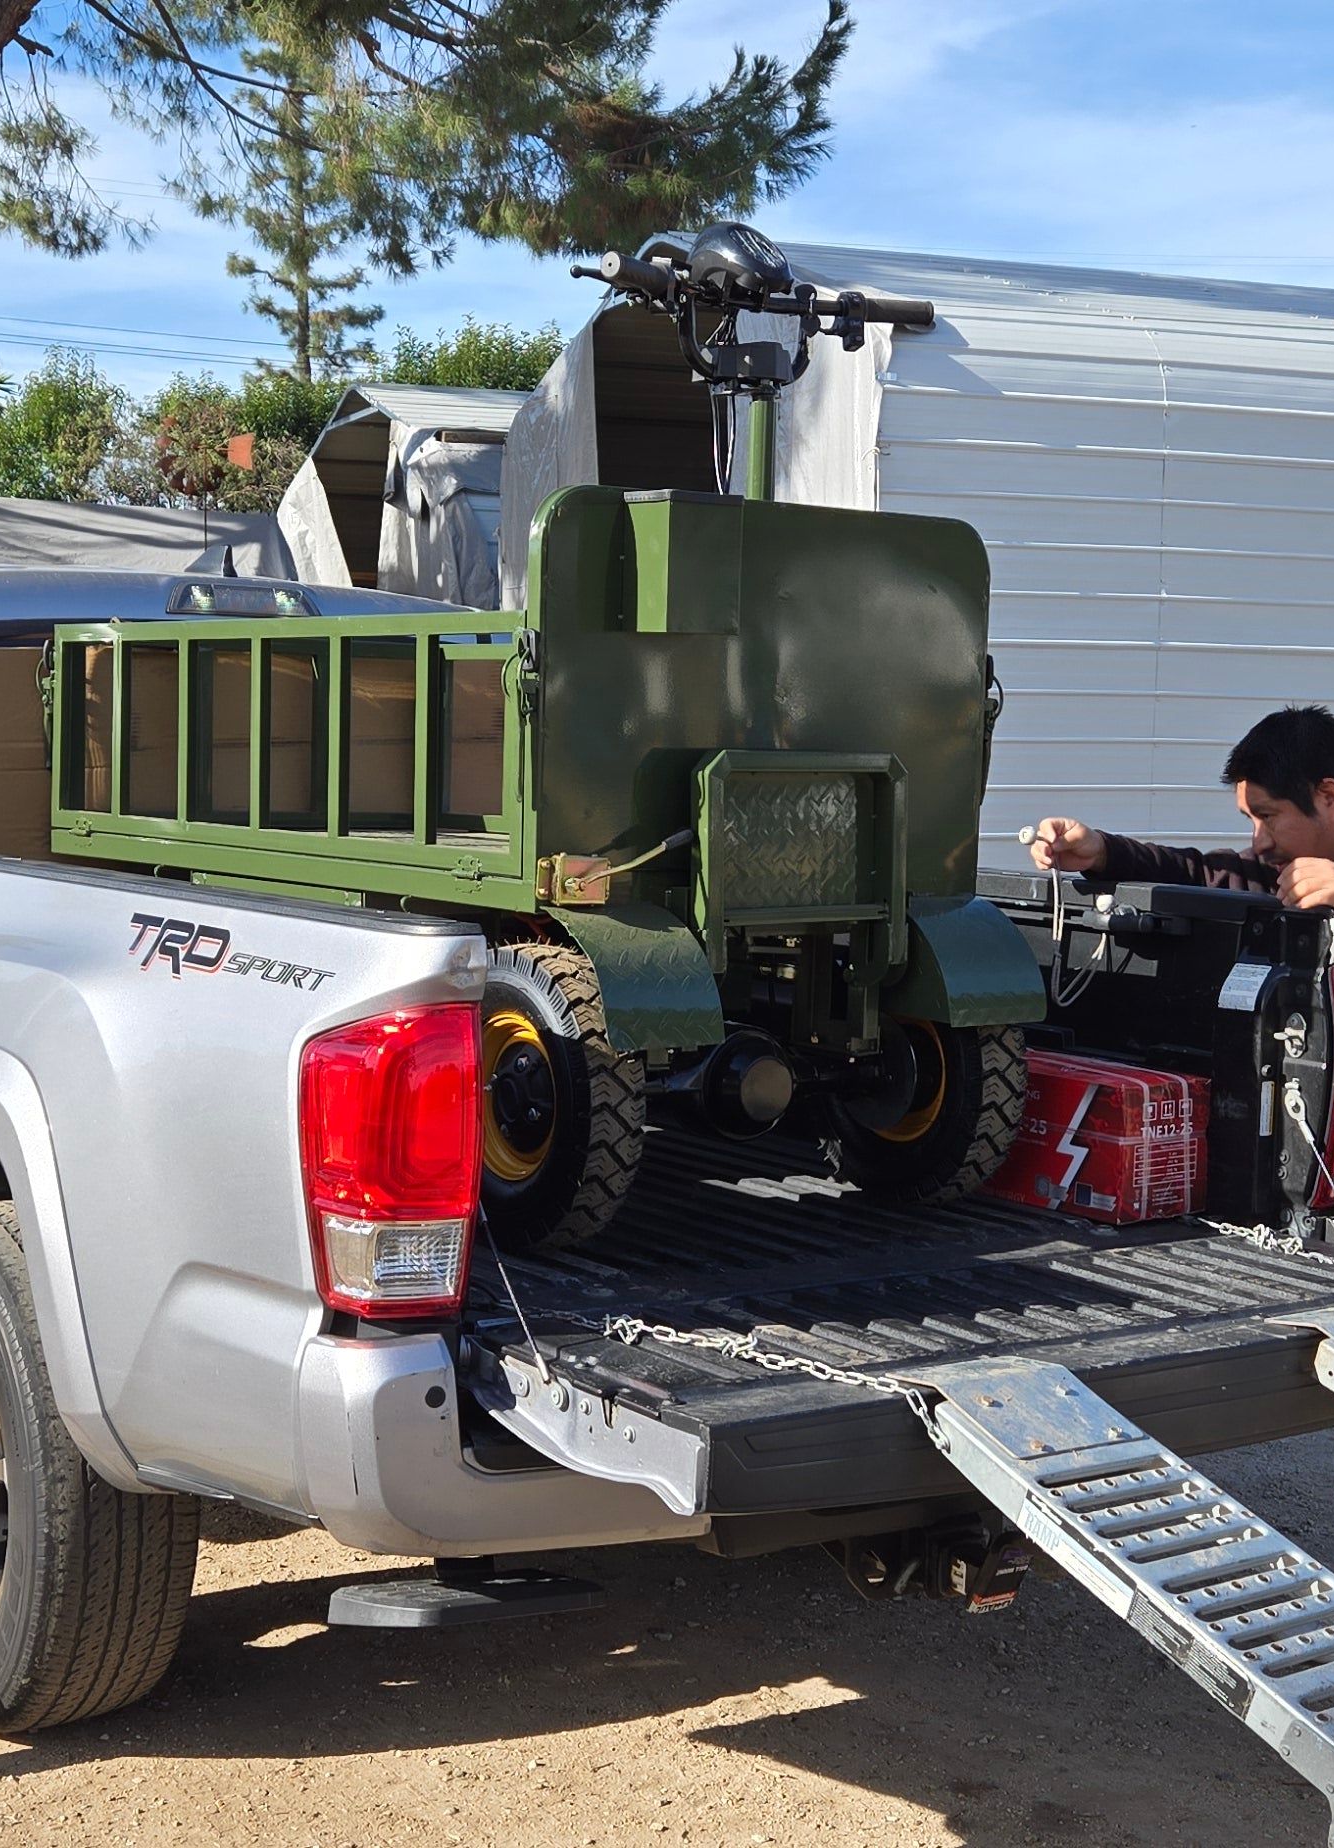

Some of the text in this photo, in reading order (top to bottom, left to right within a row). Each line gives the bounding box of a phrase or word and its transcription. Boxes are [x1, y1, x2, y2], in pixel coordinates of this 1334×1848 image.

[129, 912, 336, 991] TRD SPORT
[1140, 1121, 1193, 1139] TNE12-25
[1024, 1512, 1060, 1551] RAMP
